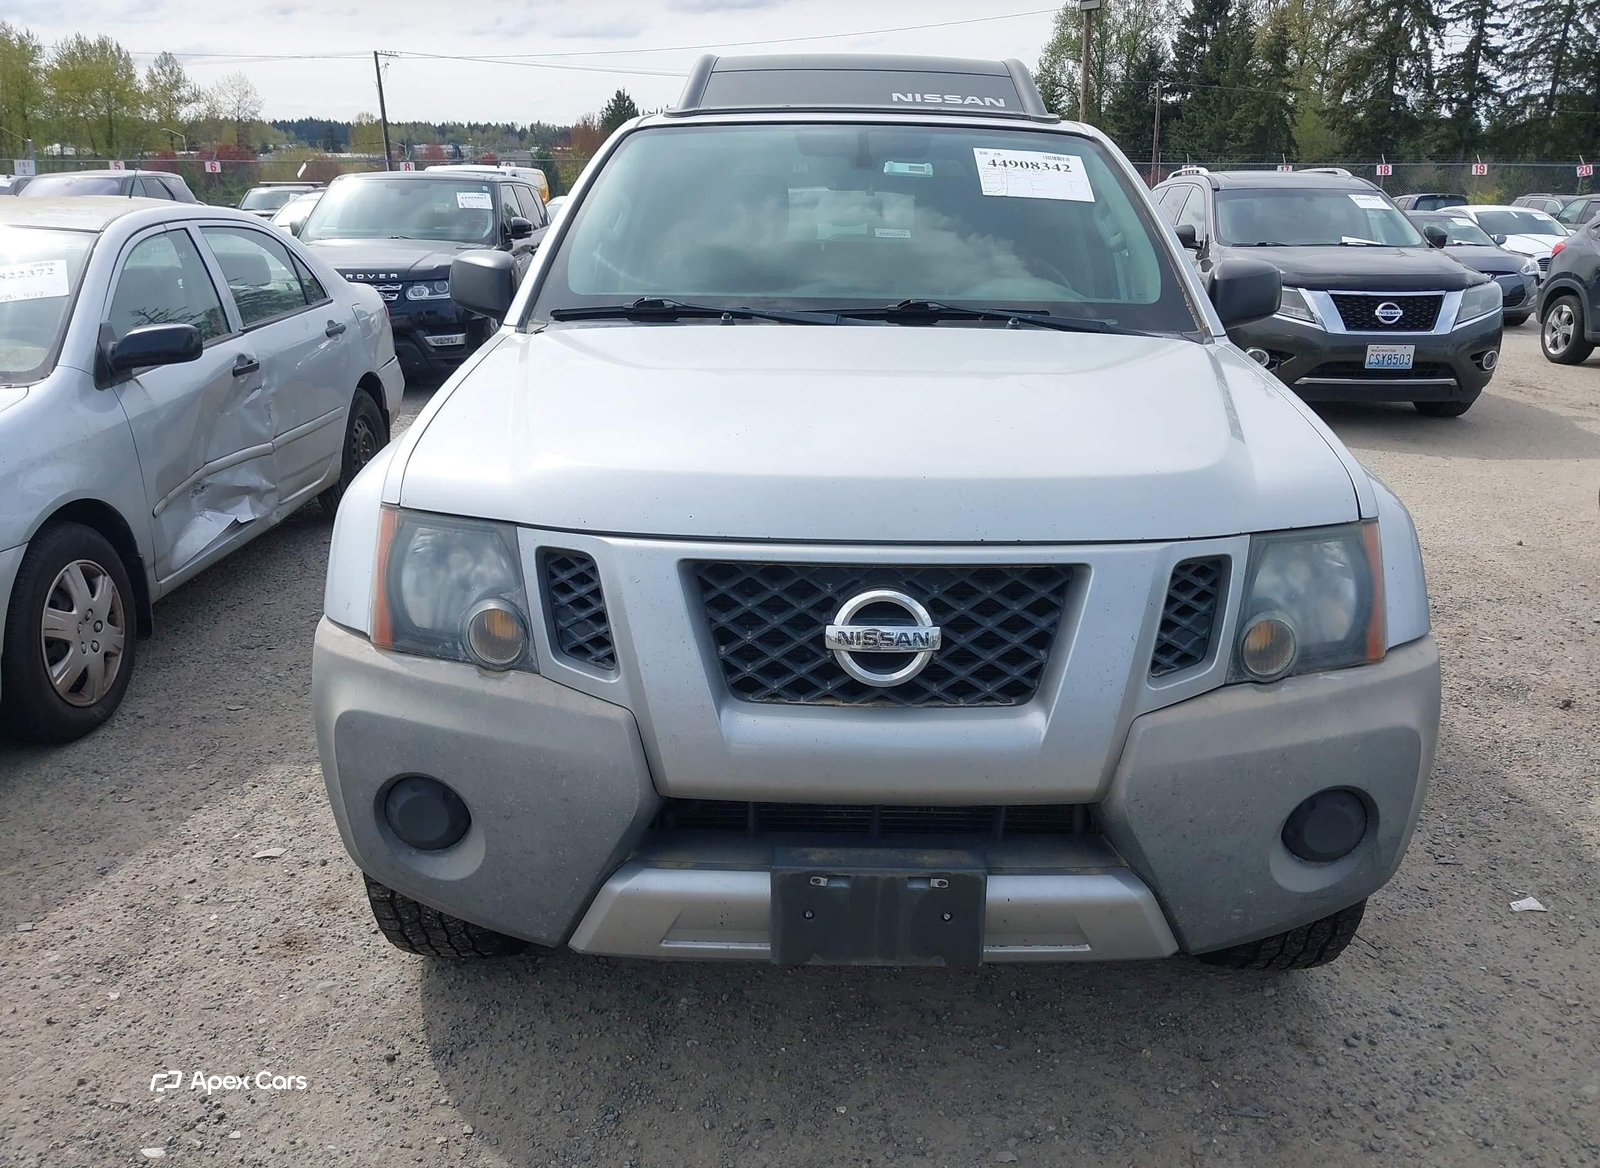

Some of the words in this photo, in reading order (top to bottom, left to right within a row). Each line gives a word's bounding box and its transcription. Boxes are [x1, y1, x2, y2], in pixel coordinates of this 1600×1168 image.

[891, 92, 1006, 108] NISSAN
[114, 161, 121, 170] 5
[210, 163, 217, 172] 6
[987, 158, 1072, 173] 44908342
[1378, 165, 1390, 175] 18
[1474, 165, 1485, 174] 19
[1578, 165, 1592, 176] 20
[1368, 353, 1411, 365] CSY8503
[837, 630, 930, 647] NISSAN
